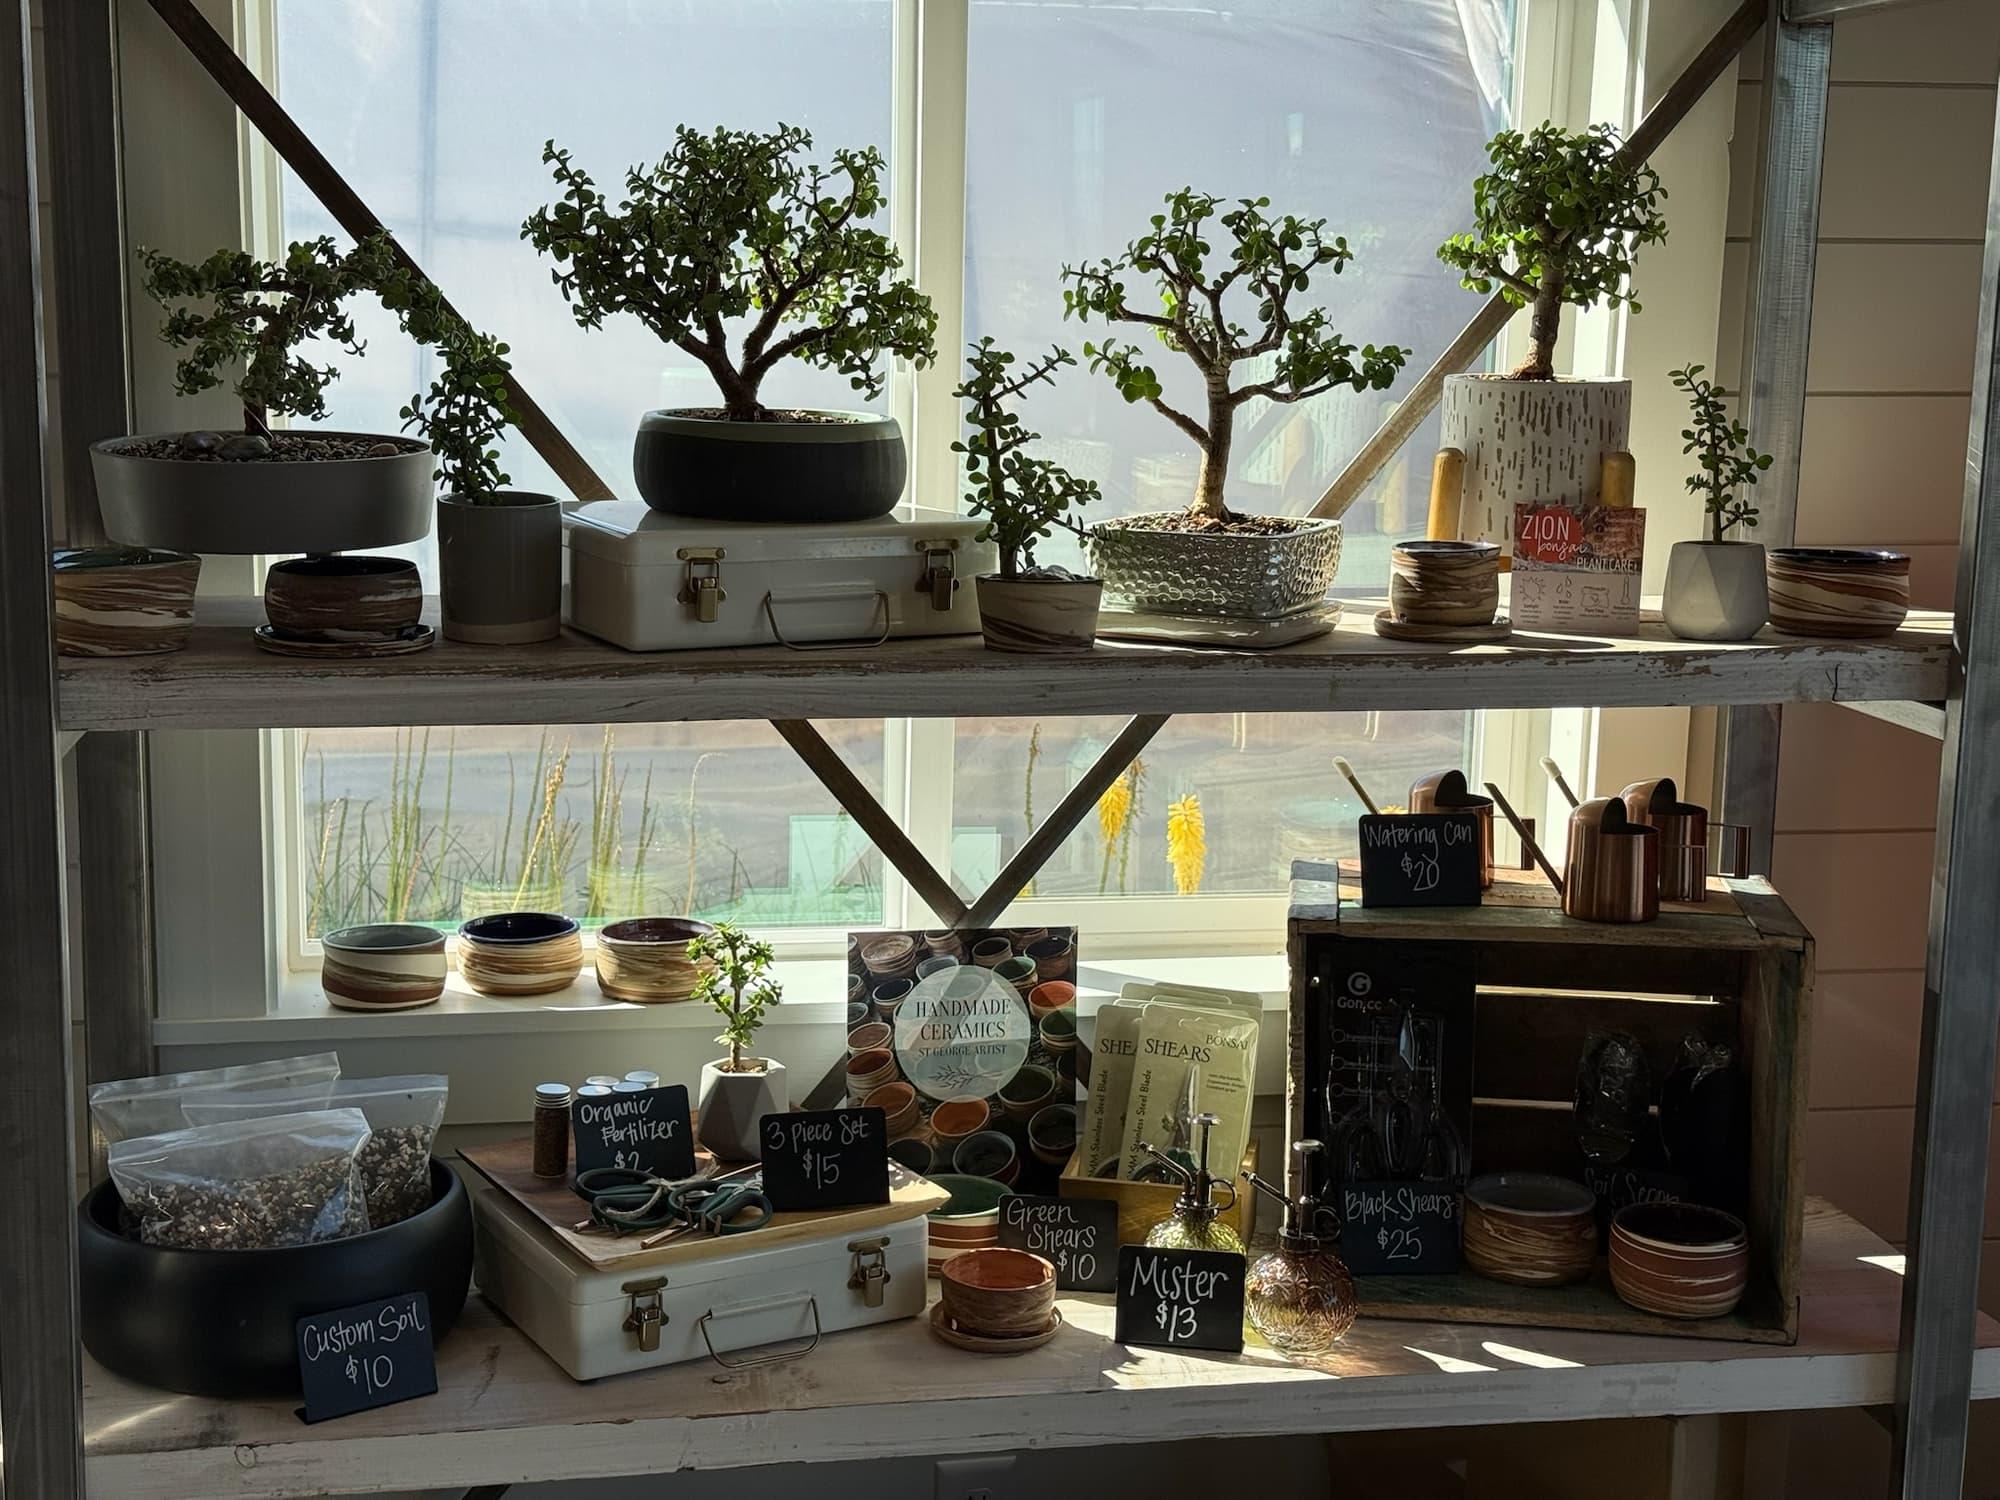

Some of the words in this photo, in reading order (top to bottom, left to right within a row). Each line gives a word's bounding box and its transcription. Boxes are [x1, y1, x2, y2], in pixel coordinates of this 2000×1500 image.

[1521, 515, 1570, 541] ZION
[1537, 532, 1589, 561] bonsai
[1576, 557, 1608, 570] PLANT
[1364, 822, 1439, 861] Watering
[1444, 821, 1472, 846] Can
[916, 999, 1011, 1018] HANDMADE
[920, 1021, 1006, 1041] CERAMICS
[1206, 1034, 1249, 1051] BONSAI
[919, 1047, 931, 1057] ST
[933, 1046, 970, 1057] GEORGE
[974, 1044, 1007, 1056] ARTIST
[1100, 1038, 1138, 1057] SHE
[1144, 1038, 1212, 1063] SHEARS
[1140, 1069, 1152, 1093] Blade
[581, 1095, 654, 1131] Organic
[600, 1117, 680, 1147] Fertilizer
[767, 1121, 786, 1150] 3
[839, 1114, 870, 1145] Set
[802, 1148, 841, 1190] $15
[1007, 1198, 1079, 1231] Green
[1344, 1190, 1400, 1224] Black
[1397, 1187, 1456, 1222] Shears
[1027, 1222, 1096, 1253] Shears
[1377, 1226, 1423, 1260] $25
[1056, 1249, 1096, 1282] $10
[1130, 1255, 1230, 1305] Mister
[304, 1320, 376, 1361] Custom
[378, 1301, 426, 1341] Soil
[1154, 1300, 1199, 1342] $13
[345, 1354, 393, 1395] $10
